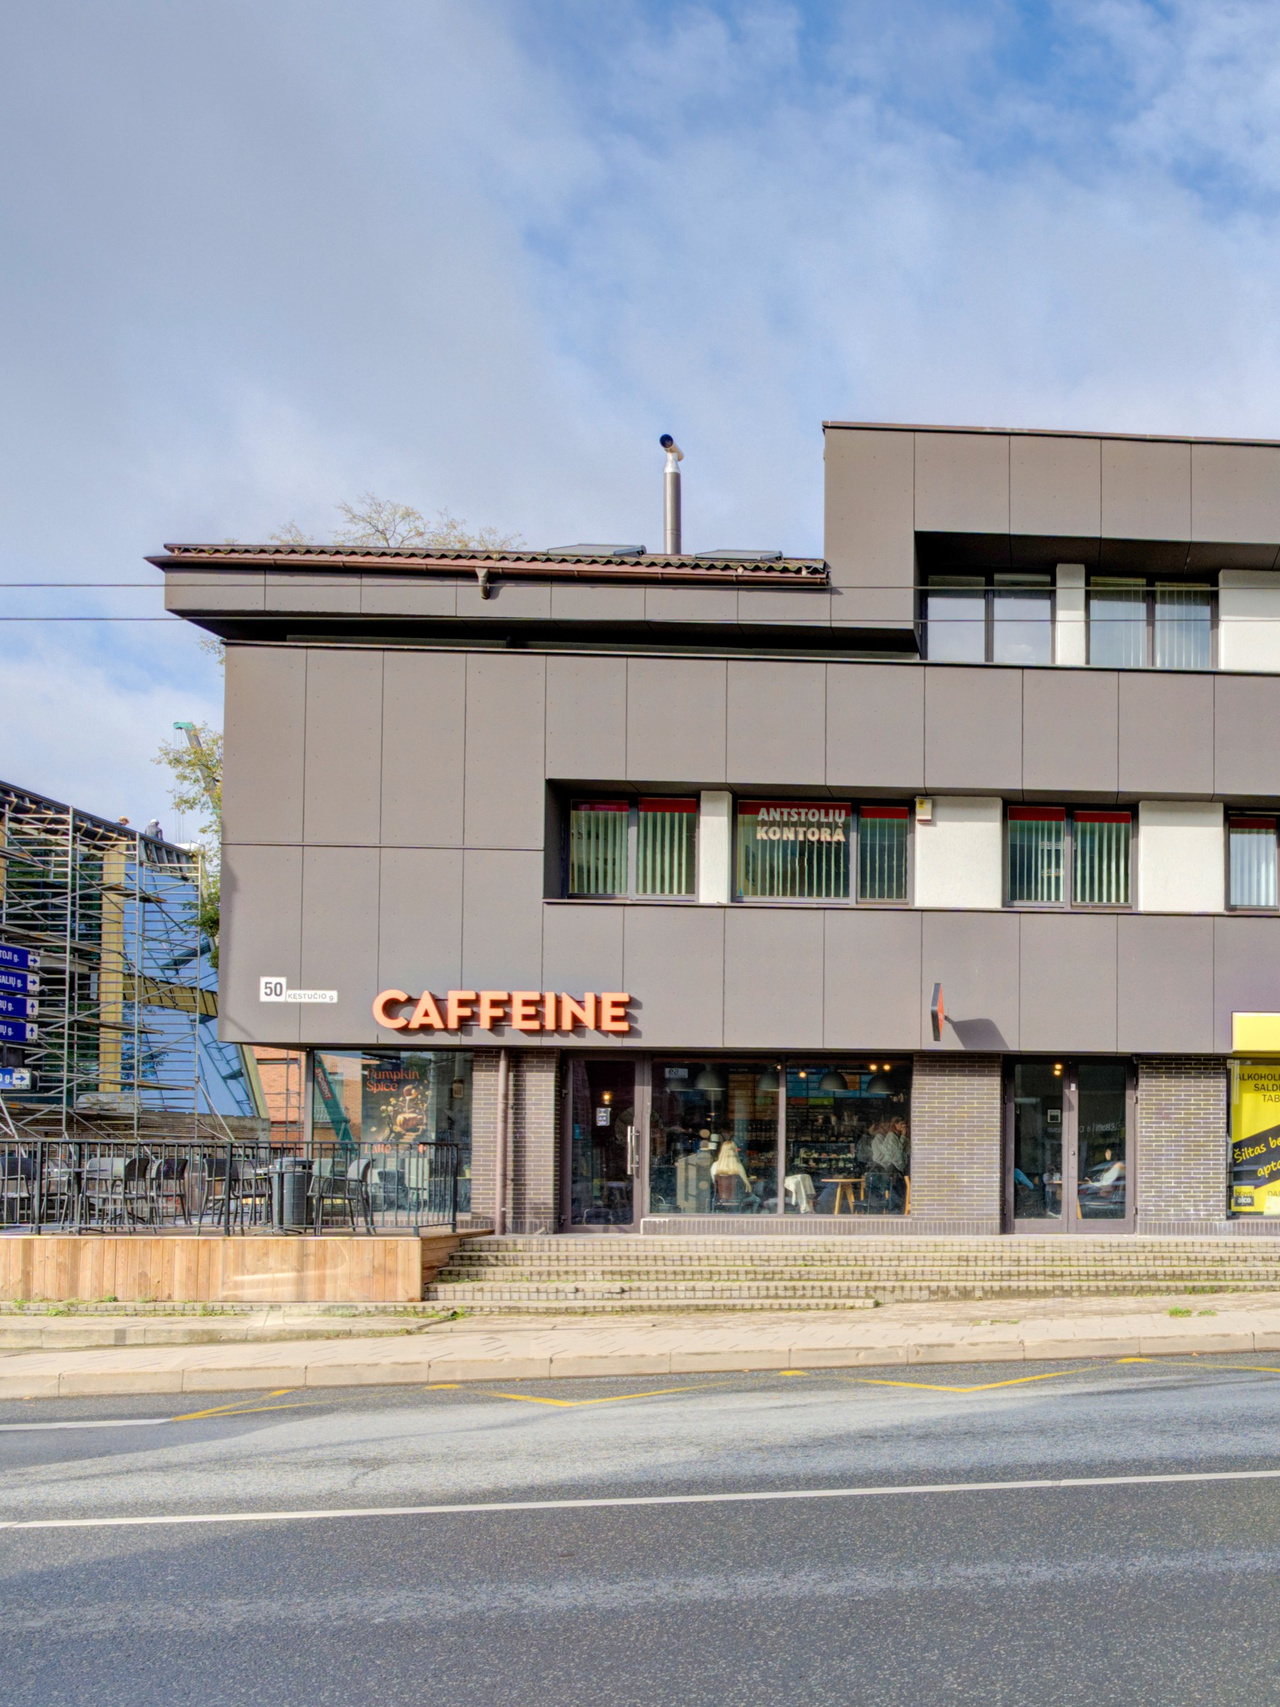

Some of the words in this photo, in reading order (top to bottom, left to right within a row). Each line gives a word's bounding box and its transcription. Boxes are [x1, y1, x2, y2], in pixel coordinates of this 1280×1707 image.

[757, 807, 846, 828] ANTSTOLIŲ
[756, 826, 846, 842] KONTORA
[264, 981, 283, 997] 50
[372, 989, 632, 1032] CAFFEINE
[366, 1068, 420, 1081] Pumpkin
[366, 1081, 398, 1093] Spice
[1234, 1143, 1267, 1163] Šiltas
